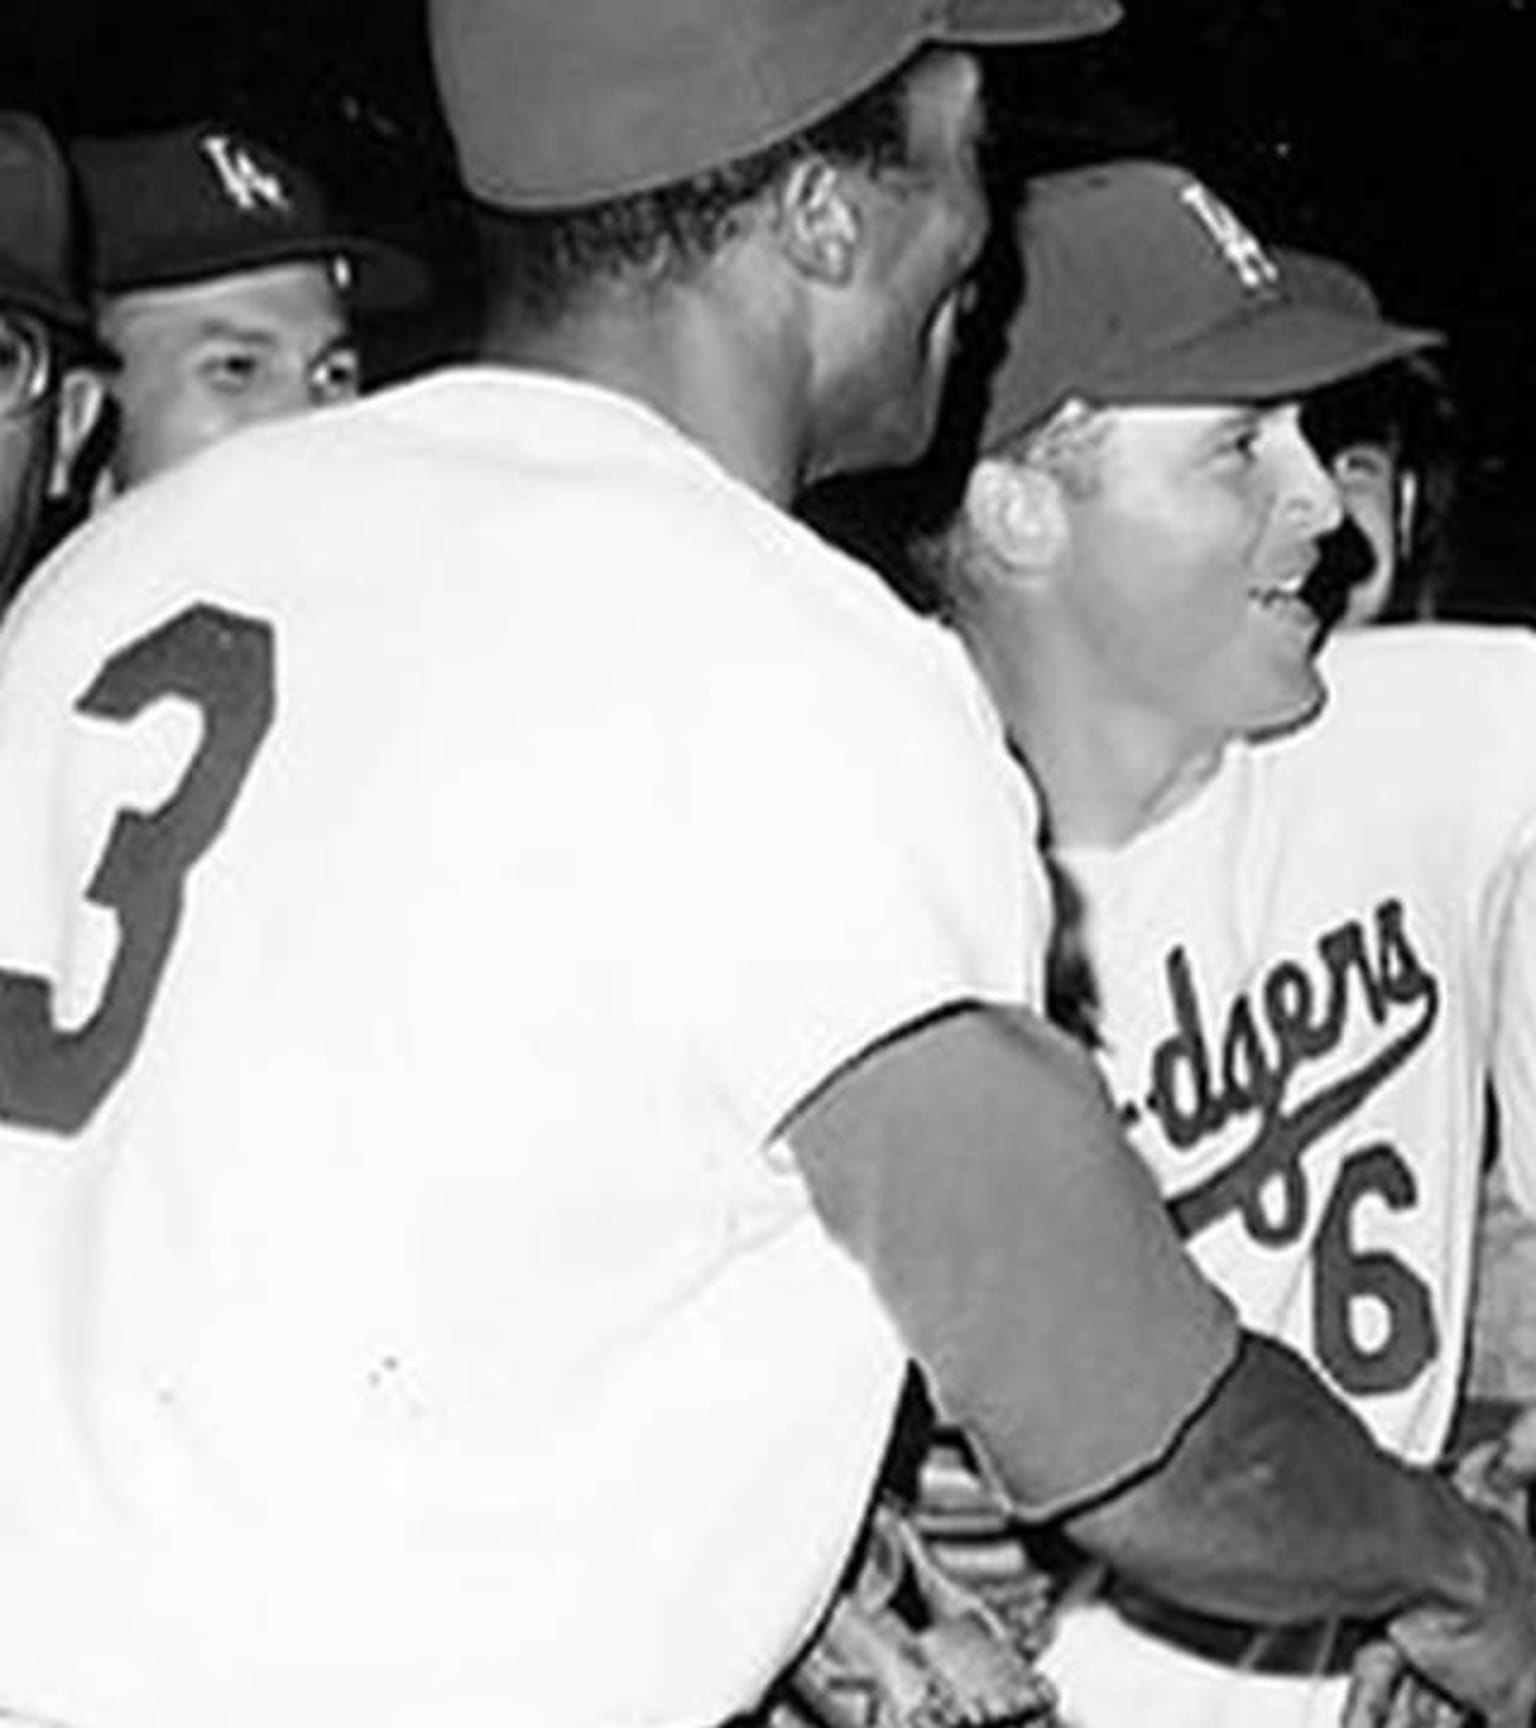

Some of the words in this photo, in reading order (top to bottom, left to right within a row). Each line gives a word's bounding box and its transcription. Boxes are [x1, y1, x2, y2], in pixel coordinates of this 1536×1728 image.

[0, 602, 276, 1137] 3
[1121, 899, 1438, 1248] dgers
[1314, 1145, 1438, 1395] 6
